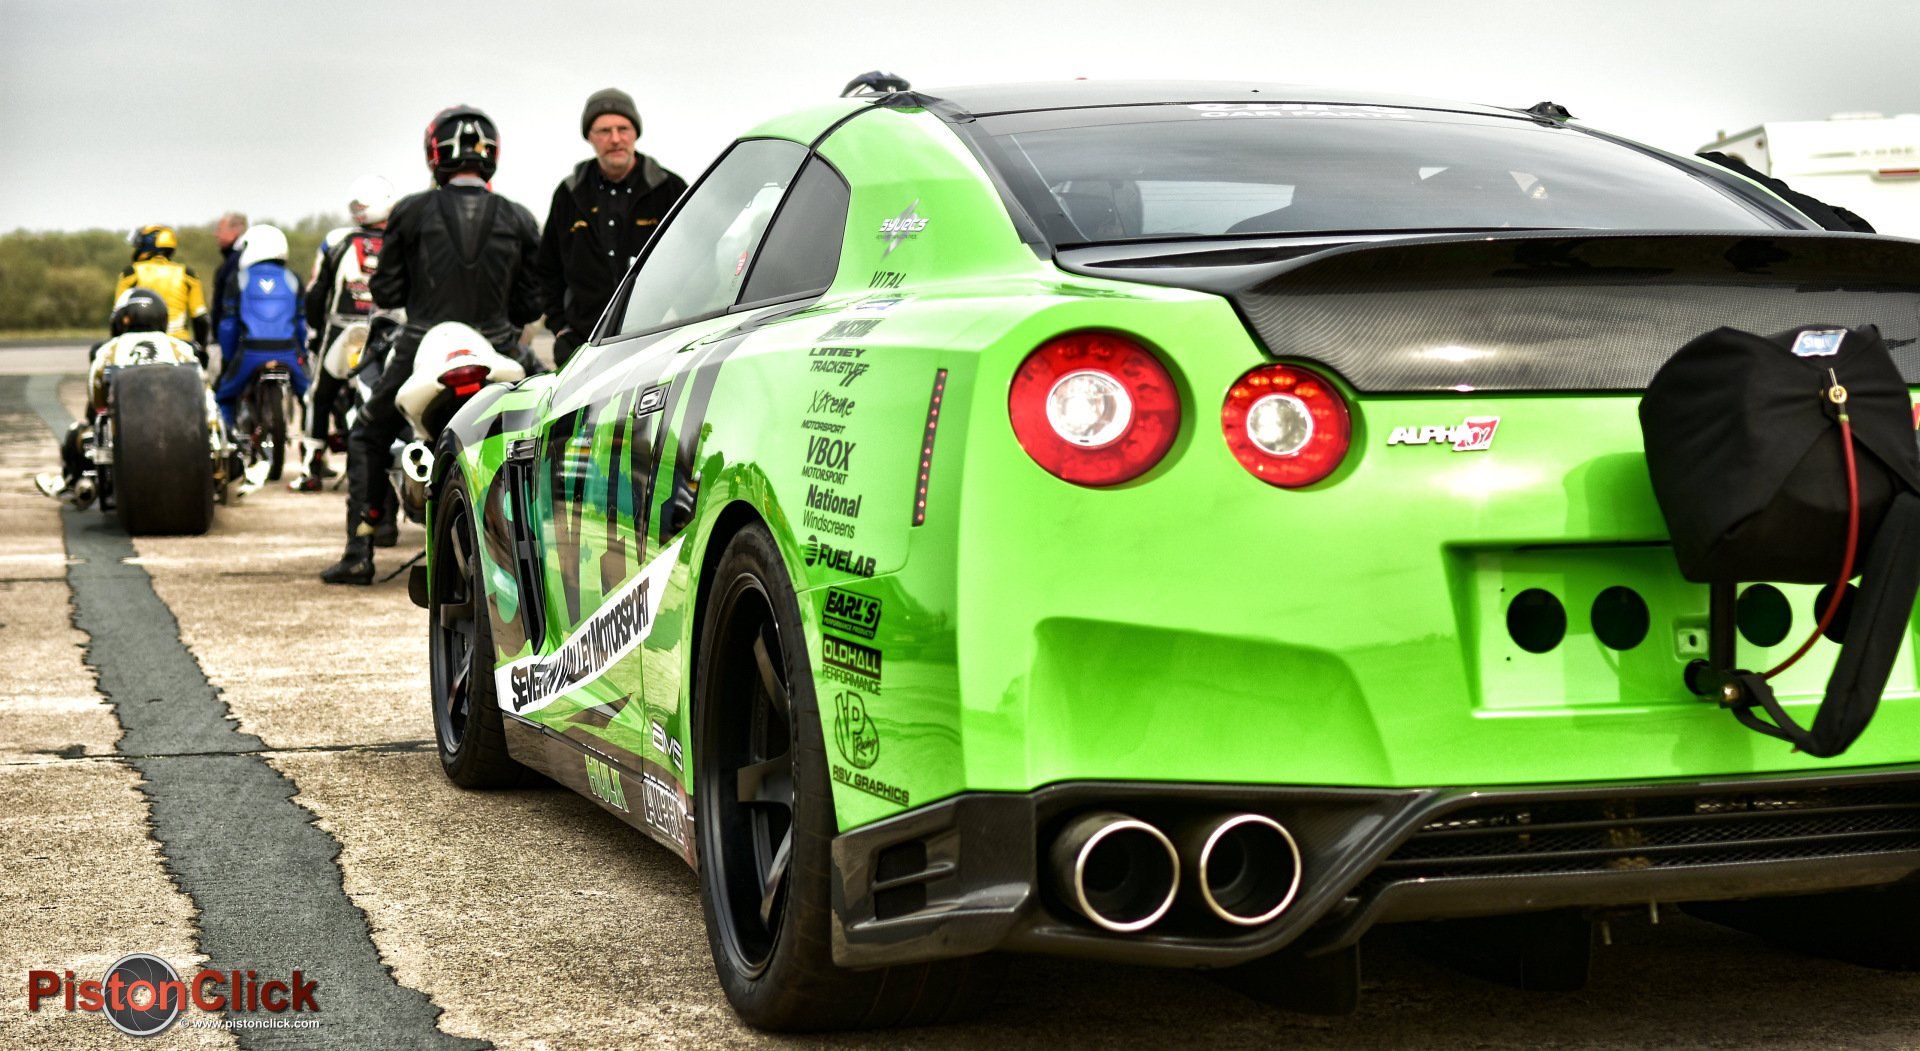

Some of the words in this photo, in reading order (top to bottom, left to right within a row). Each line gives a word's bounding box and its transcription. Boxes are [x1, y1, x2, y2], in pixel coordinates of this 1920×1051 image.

[868, 270, 907, 289] VITAL
[810, 360, 870, 387] TRACKSTUFF
[806, 389, 855, 418] Xtreme
[801, 419, 846, 434] MOTORSPORT
[806, 435, 856, 471] VBOX
[802, 465, 848, 485] MOTORSPORT
[806, 483, 862, 518] National
[803, 509, 855, 539] Windscreens
[825, 590, 878, 624] EARL'S
[590, 576, 650, 673] MOTORSPORT
[823, 640, 880, 674] OLDHALL
[822, 663, 882, 697] PERFORMANCE
[833, 764, 852, 783] RSV
[854, 773, 909, 805] GRAPHICS
